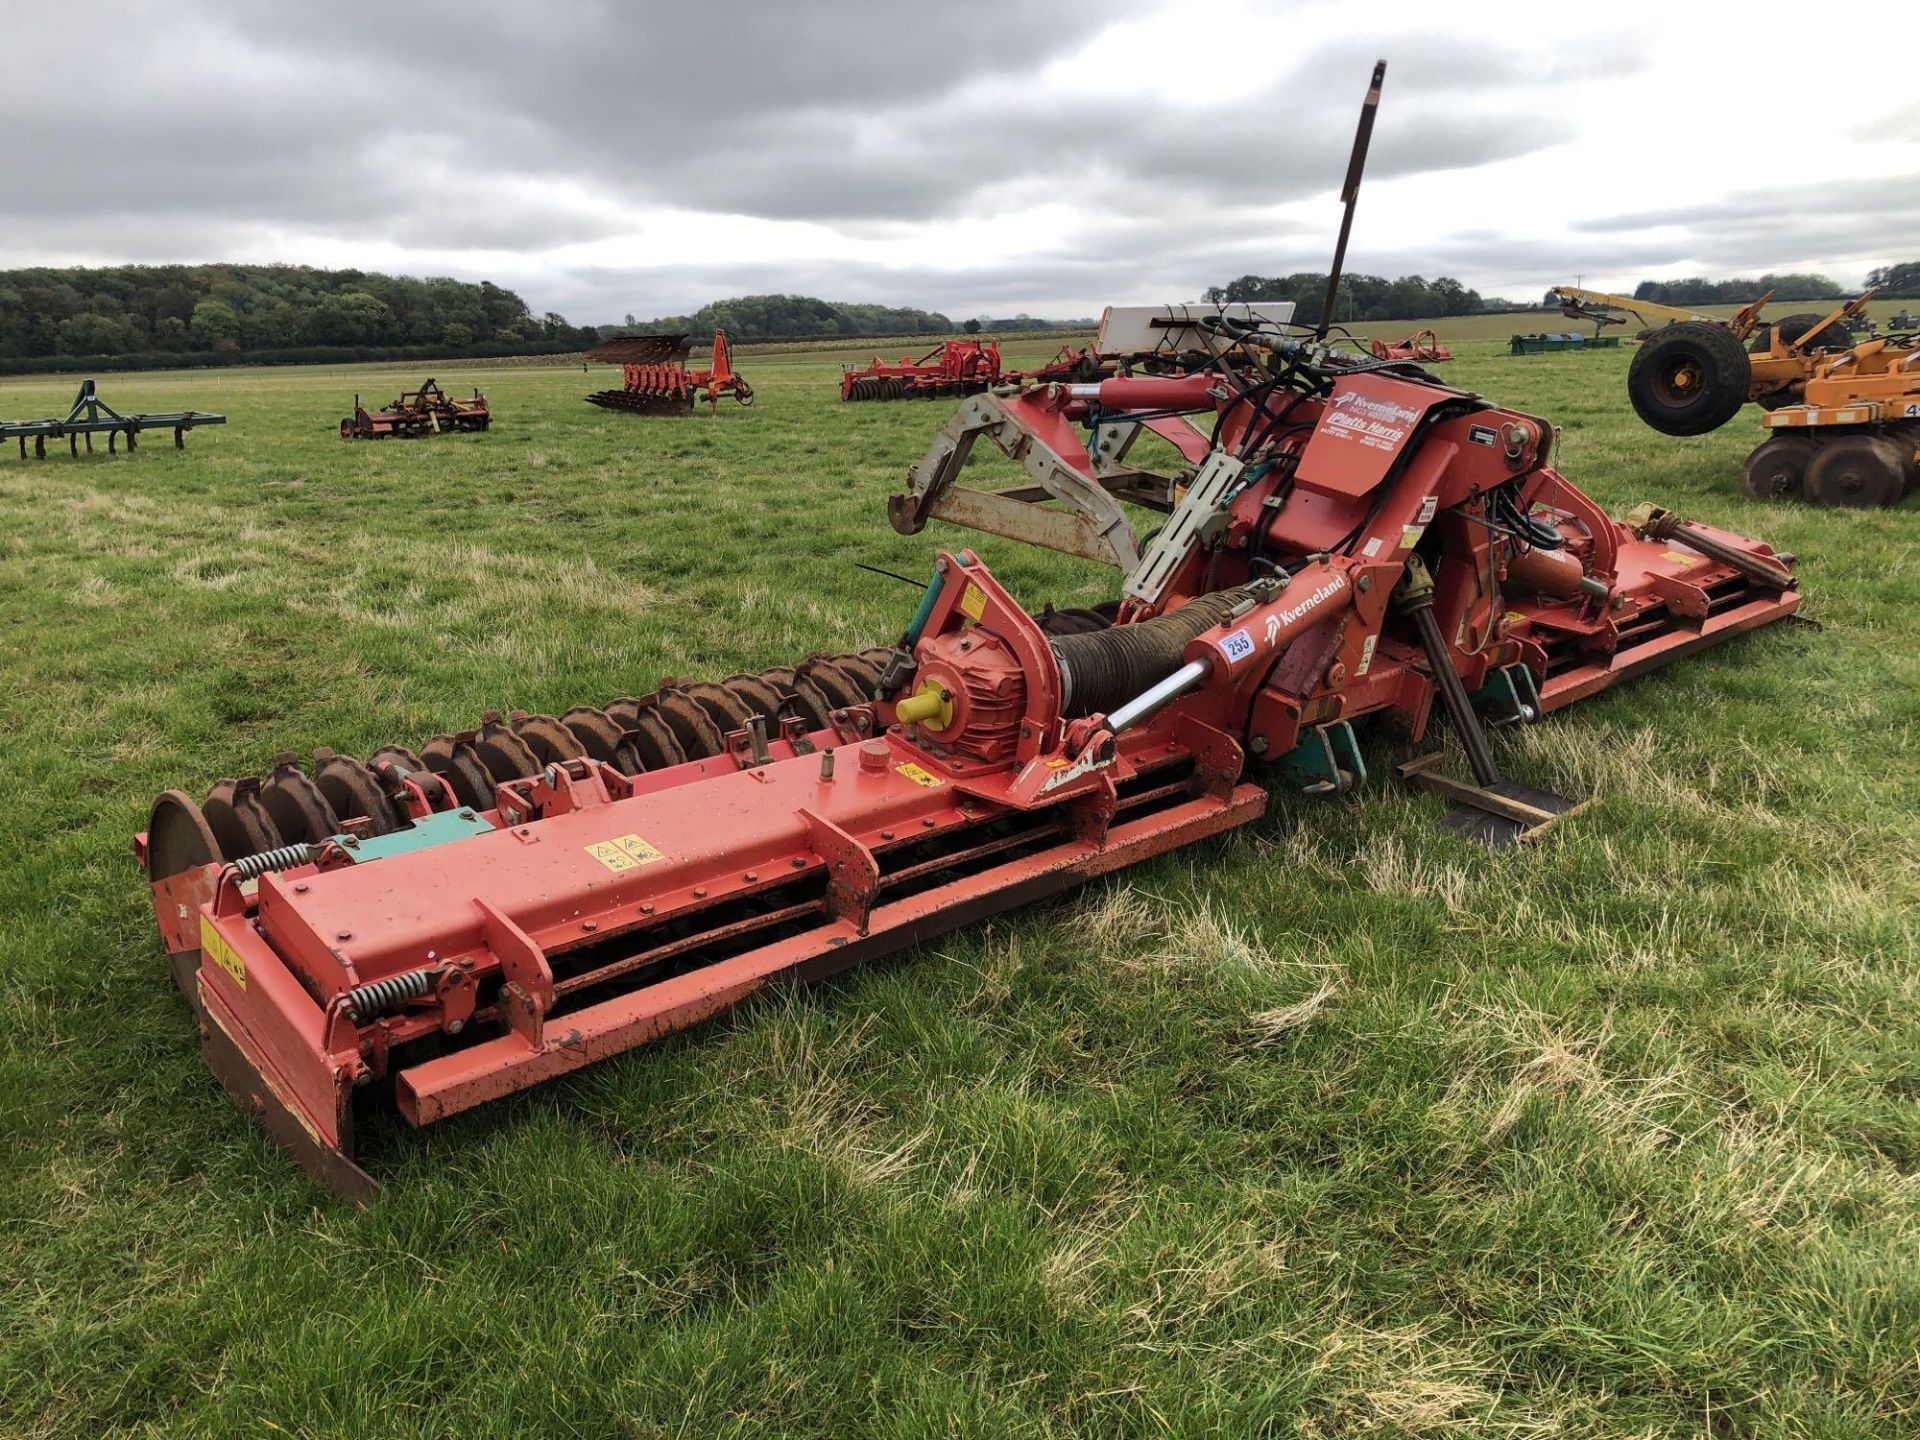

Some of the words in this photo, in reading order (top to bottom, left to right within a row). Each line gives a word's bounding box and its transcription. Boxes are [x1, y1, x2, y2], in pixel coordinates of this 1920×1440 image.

[1354, 396, 1421, 423] Kverneland
[1331, 412, 1367, 429] Platts
[1367, 421, 1404, 439] Harris
[1279, 574, 1345, 626] Kverneland
[1228, 636, 1250, 656] 255
